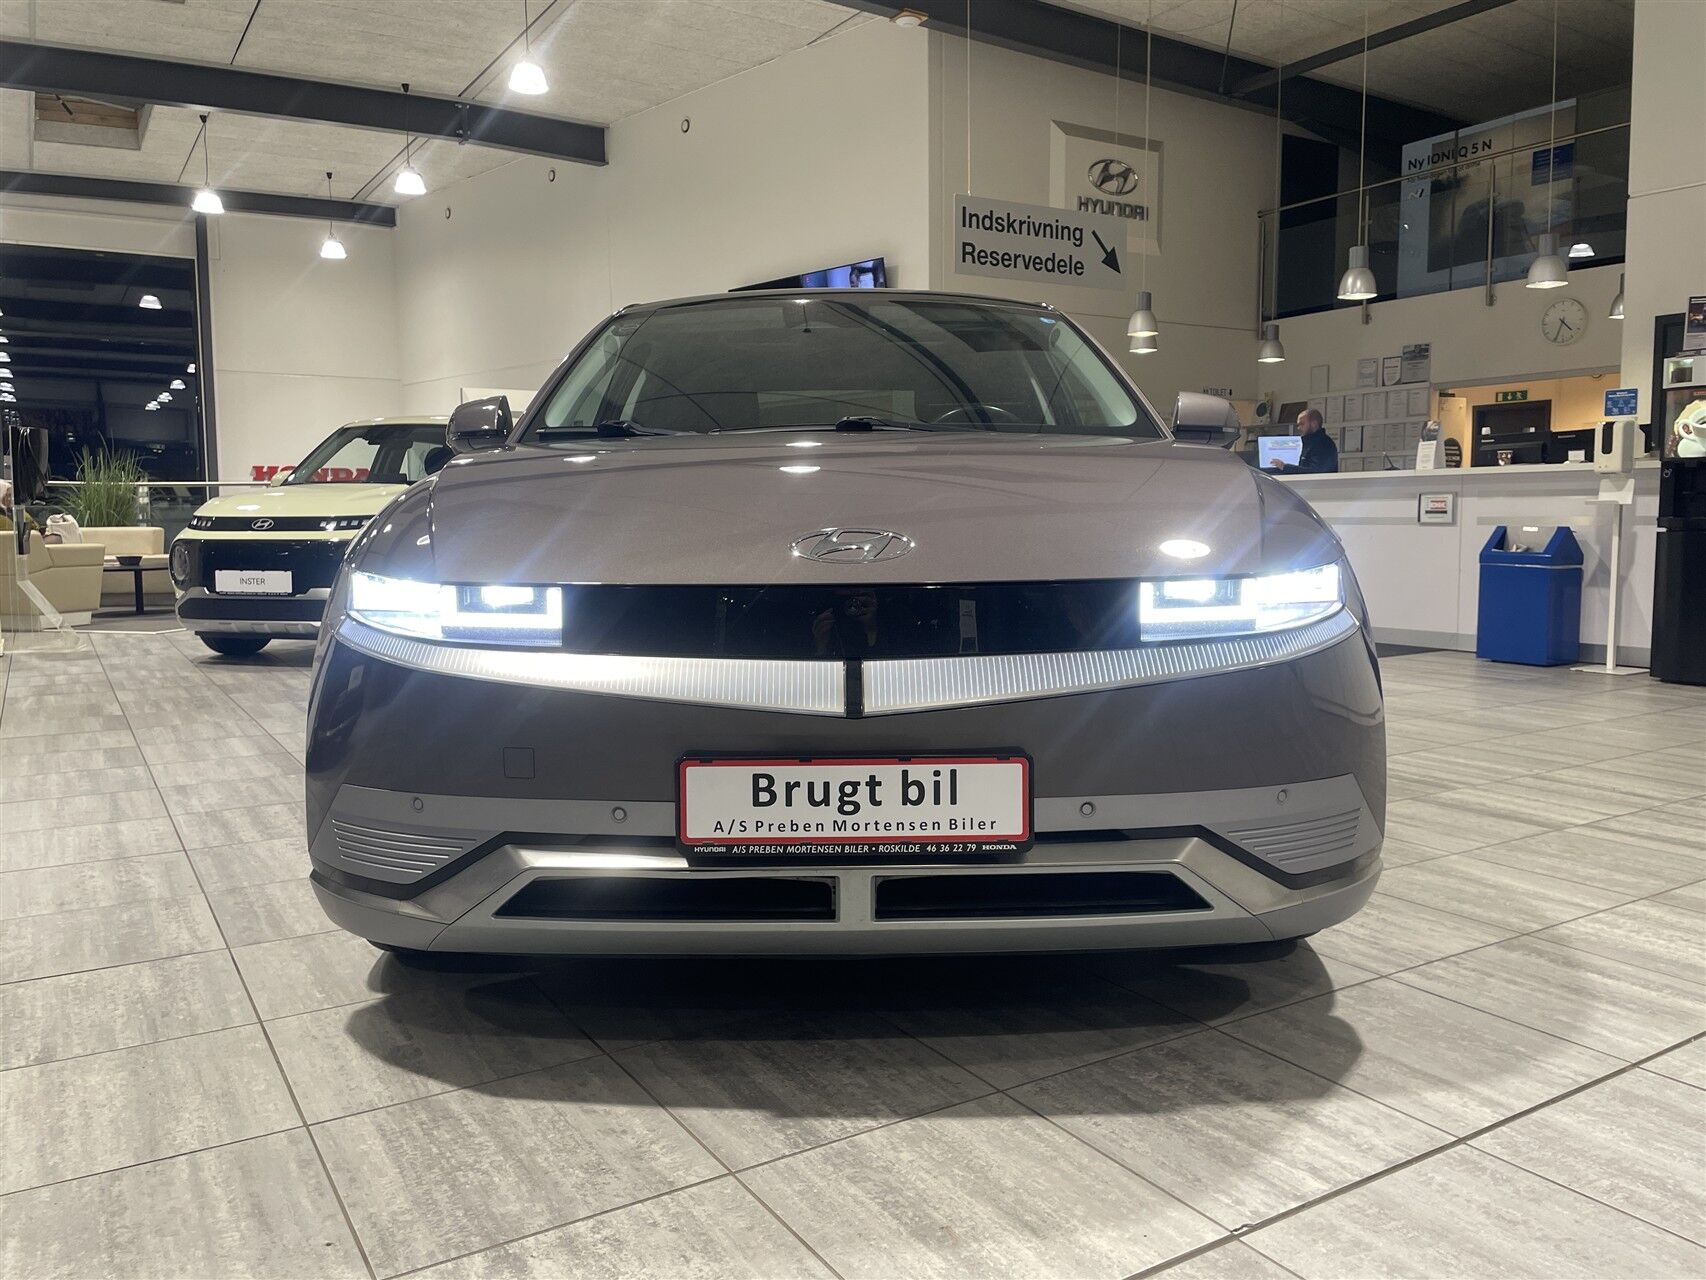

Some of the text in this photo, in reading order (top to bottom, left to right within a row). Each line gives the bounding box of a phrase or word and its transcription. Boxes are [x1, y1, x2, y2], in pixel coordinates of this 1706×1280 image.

[1408, 158, 1424, 170] Ny
[1471, 143, 1479, 155] 5
[1482, 139, 1492, 151] N
[1077, 196, 1149, 221] HYUNDAI
[962, 206, 1084, 247] Indskrivning
[962, 241, 1085, 276] Reservedele
[240, 577, 266, 585] INSTER
[752, 769, 958, 816] Brugt bil
[713, 818, 997, 835] A/S Preben Mortensen Biler
[732, 845, 747, 854] A/S
[749, 845, 784, 854] PREBEN
[786, 845, 843, 854] MORTENSEN
[844, 845, 869, 853] BILER
[878, 844, 921, 853] ROSKILDE
[926, 844, 937, 852] 46
[939, 844, 950, 852] 36
[953, 844, 963, 852] 22
[966, 844, 977, 852] 79
